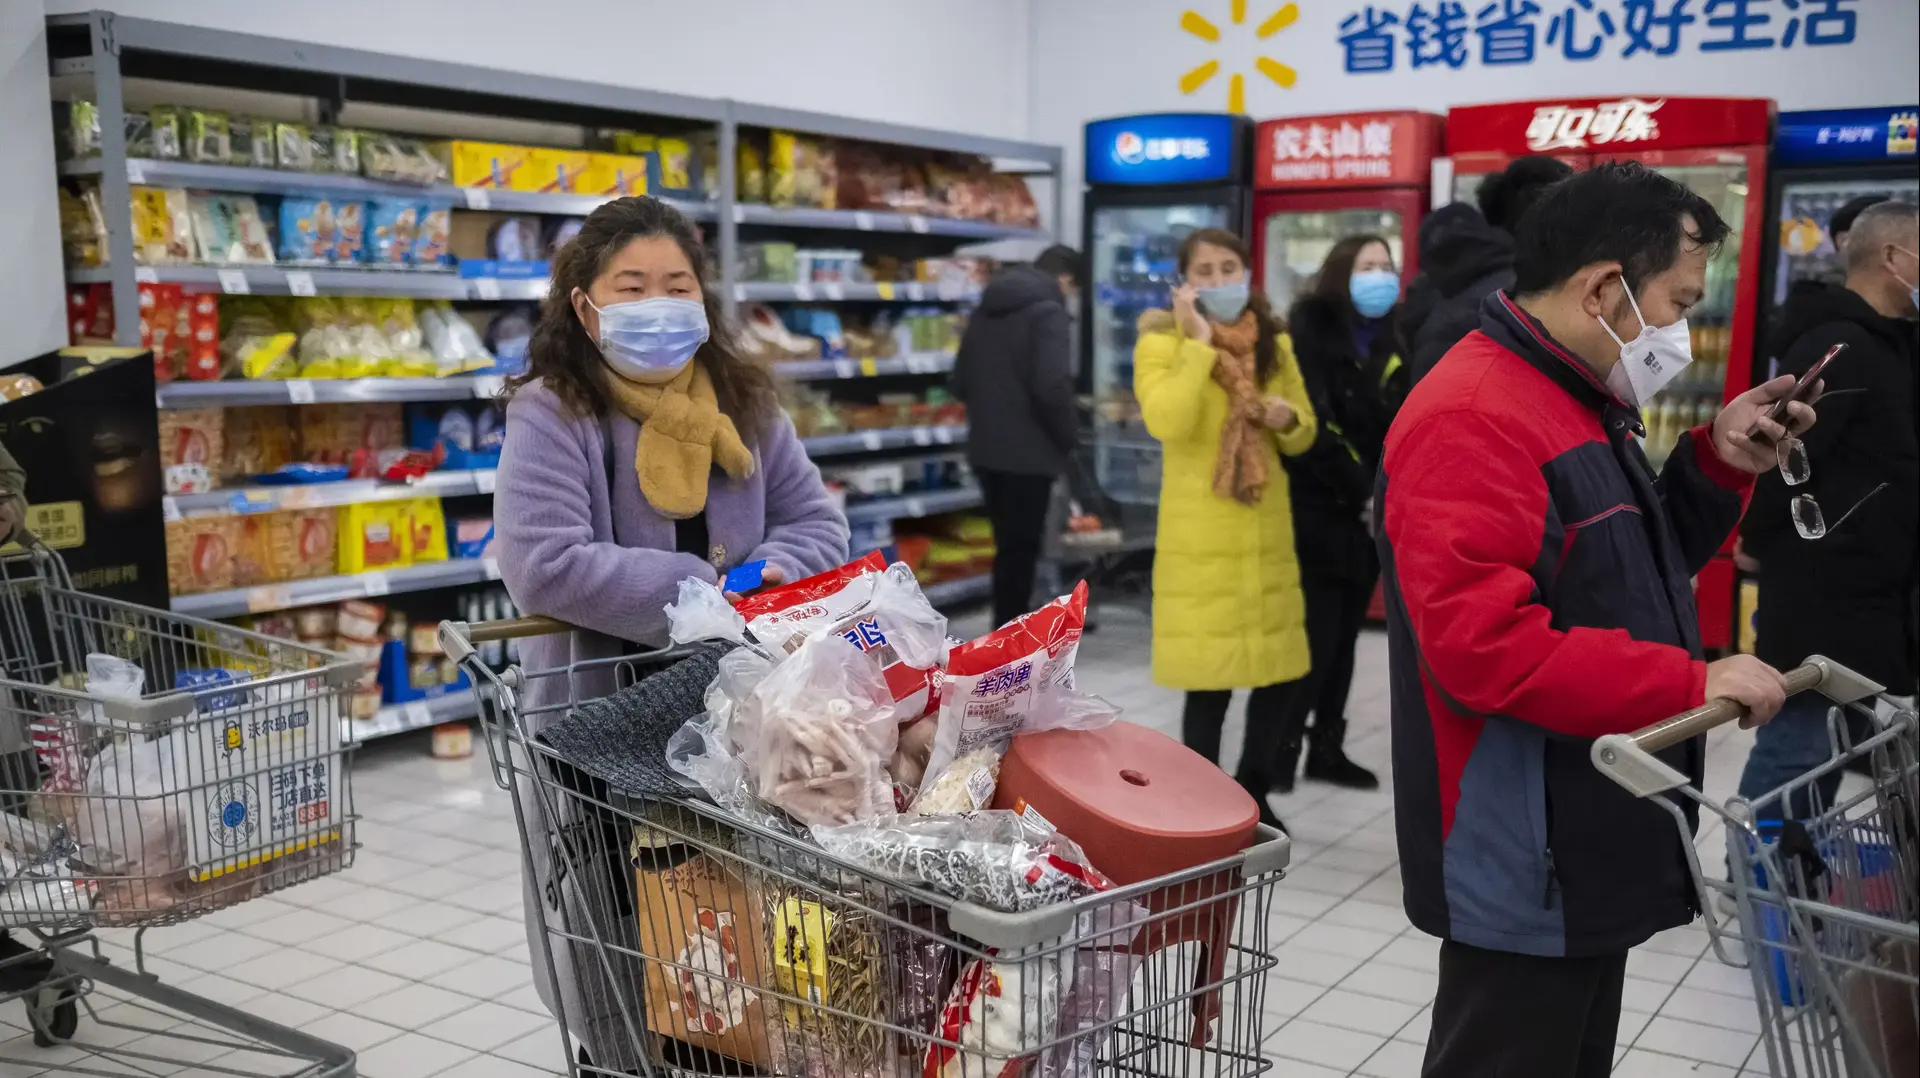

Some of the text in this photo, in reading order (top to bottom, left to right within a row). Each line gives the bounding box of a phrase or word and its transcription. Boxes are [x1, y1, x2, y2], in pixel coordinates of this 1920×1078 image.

[1337, 0, 1857, 74] 省钱省心好生活
[1273, 120, 1392, 160] 农夫山泉
[1526, 98, 1667, 151] 可口可乐
[973, 662, 1031, 696] 羊肉串
